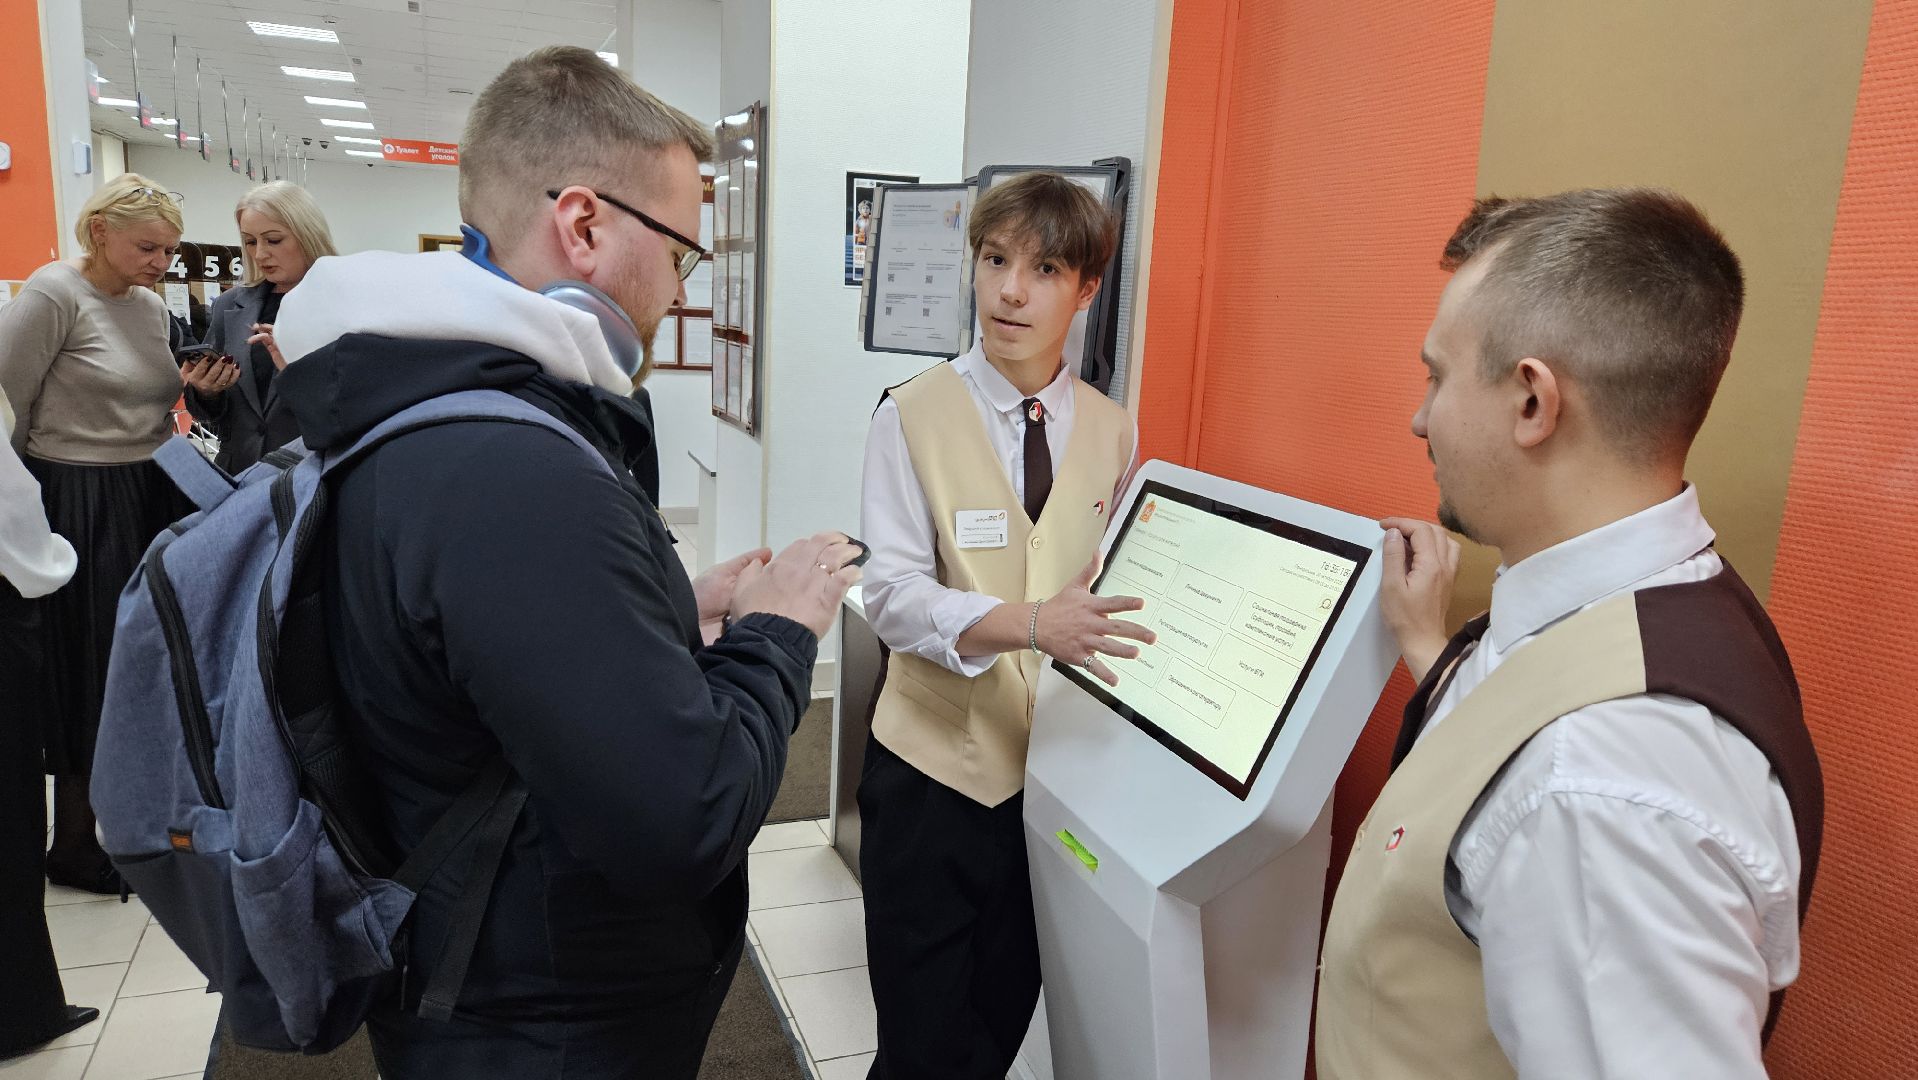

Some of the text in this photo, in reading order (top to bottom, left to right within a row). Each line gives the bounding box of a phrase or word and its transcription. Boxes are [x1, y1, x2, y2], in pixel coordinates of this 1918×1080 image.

[394, 145, 419, 154] Туалет
[428, 145, 458, 154] Детский
[431, 153, 456, 161] уголок
[167, 254, 244, 278] 4 5 6
